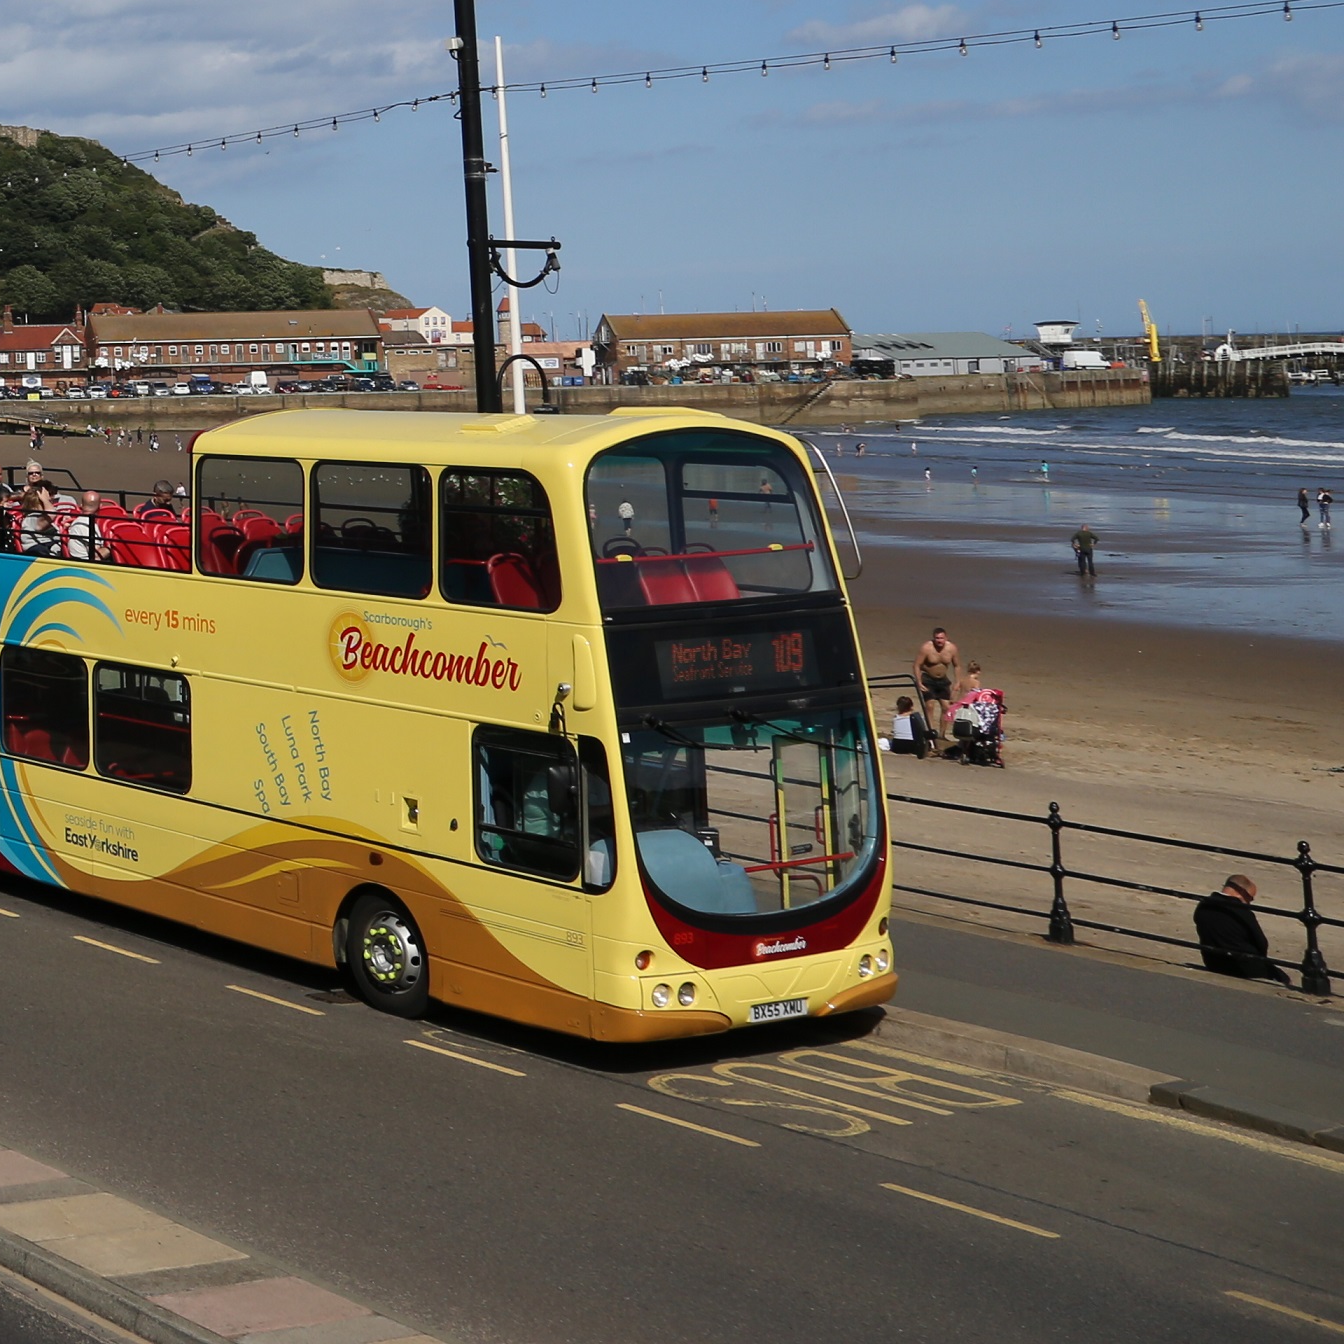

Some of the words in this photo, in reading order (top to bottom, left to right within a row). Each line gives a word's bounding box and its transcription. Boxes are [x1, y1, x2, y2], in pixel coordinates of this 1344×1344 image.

[125, 608, 161, 631] every
[164, 609, 179, 629] 15
[182, 613, 216, 634] mins
[364, 610, 432, 631] Scarborough's
[340, 626, 522, 691] Beachcomber
[672, 640, 718, 664] North
[722, 638, 752, 660] Bay
[256, 722, 278, 772] South
[274, 773, 291, 806] Bay
[281, 715, 299, 759] Luna
[295, 762, 312, 803] Park
[308, 710, 326, 762] North
[318, 767, 332, 801] Bay
[254, 779, 270, 814] Spa
[65, 813, 97, 830] seaside
[99, 819, 114, 833] fun
[115, 826, 135, 840] with
[566, 931, 583, 944] 893
[756, 938, 807, 956] Beachcomber
[754, 1004, 780, 1019] BX55
[783, 1001, 803, 1016] XMU
[647, 1050, 1024, 1137] BUS
